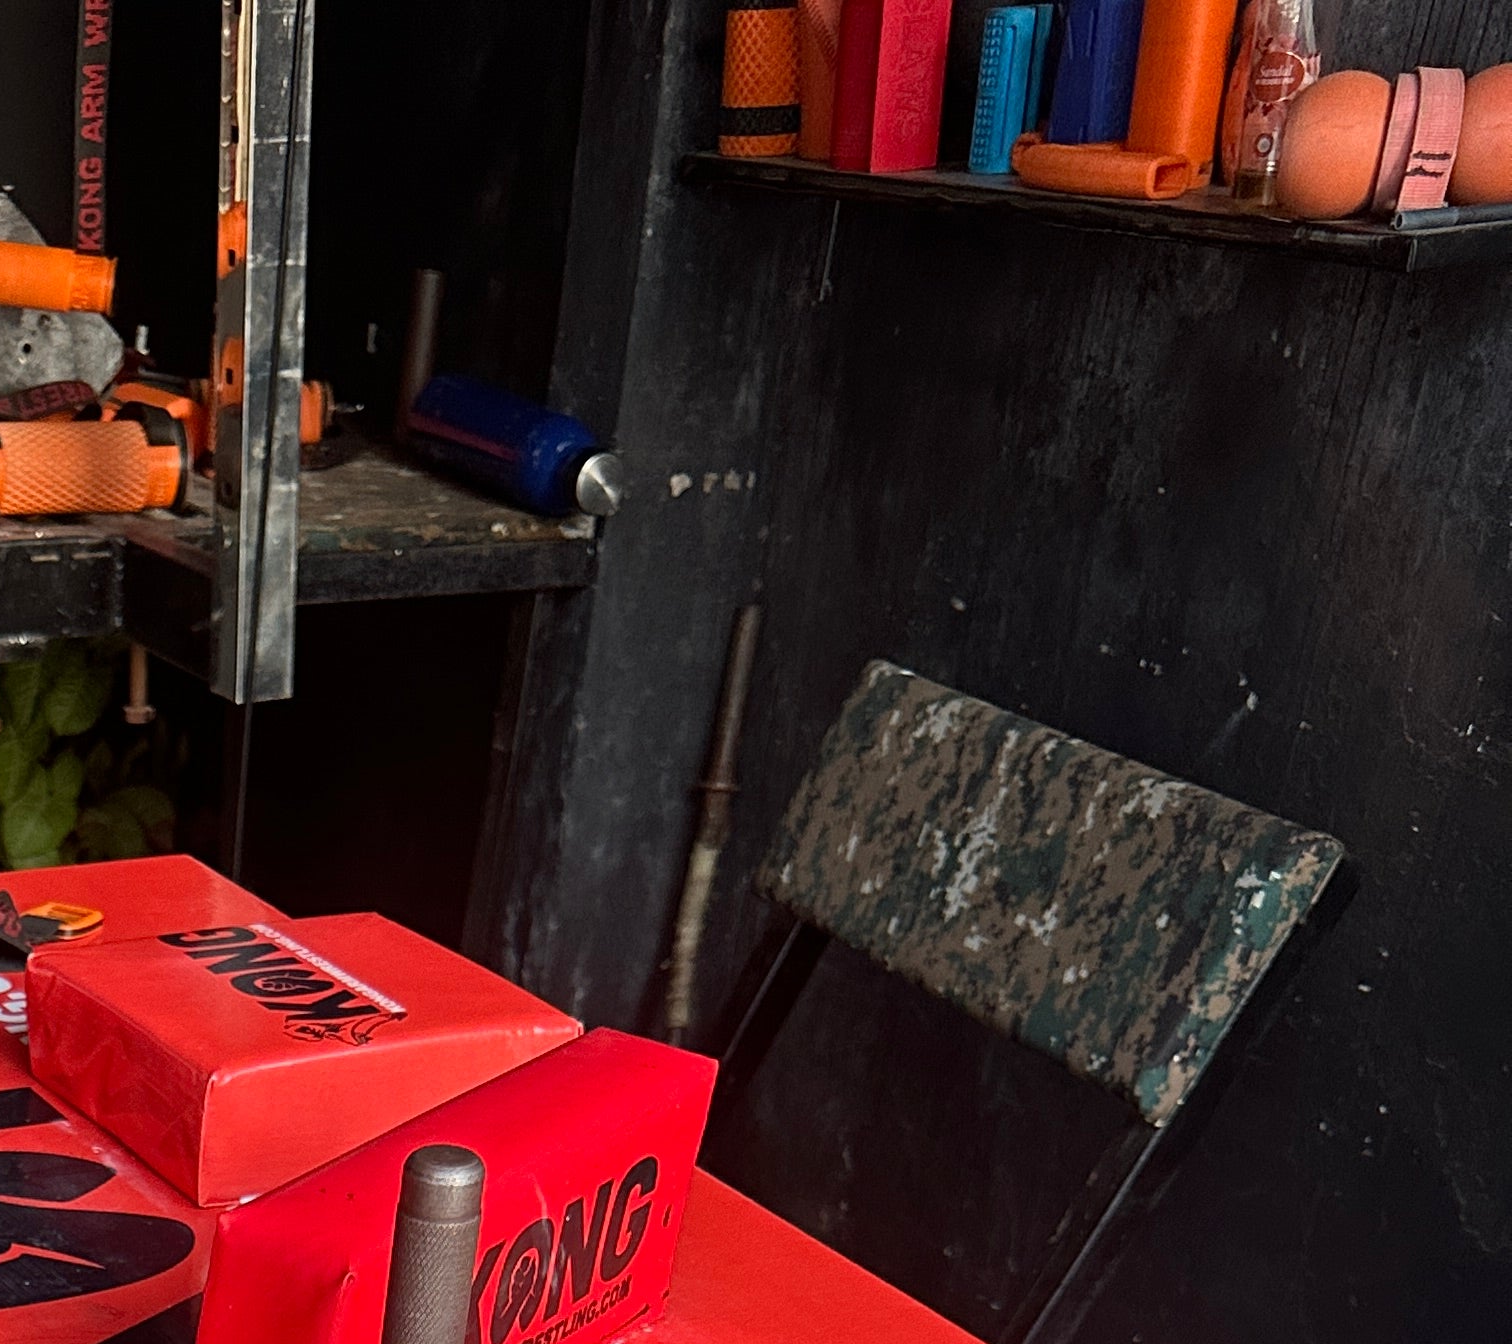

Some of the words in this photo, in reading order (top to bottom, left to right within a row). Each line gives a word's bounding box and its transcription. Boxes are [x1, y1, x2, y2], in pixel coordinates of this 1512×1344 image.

[80, 64, 108, 143] ARM
[77, 157, 103, 250] KONG
[156, 926, 381, 1022] KONG
